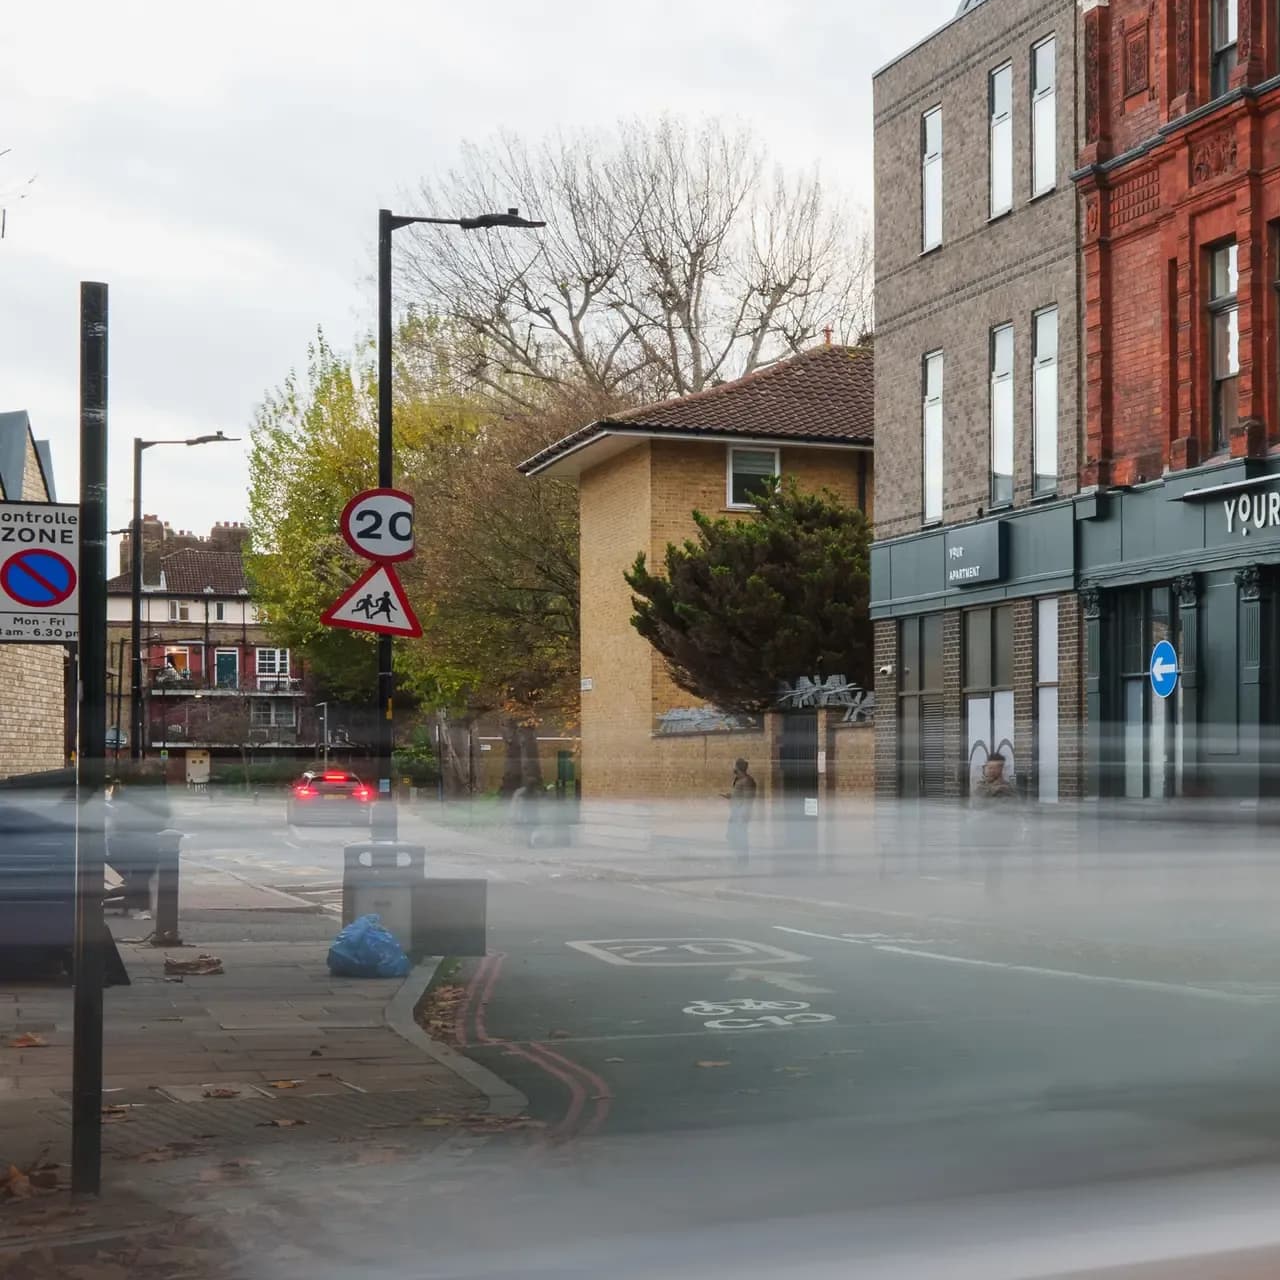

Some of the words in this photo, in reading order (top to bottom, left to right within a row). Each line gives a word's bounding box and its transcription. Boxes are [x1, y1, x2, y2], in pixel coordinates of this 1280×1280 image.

[1, 511, 78, 525] ontrolle
[356, 509, 413, 541] 20
[1, 527, 74, 544] ZONE
[13, 617, 39, 626] Mon
[50, 618, 65, 626] Fri
[33, 628, 62, 638] 6.30
